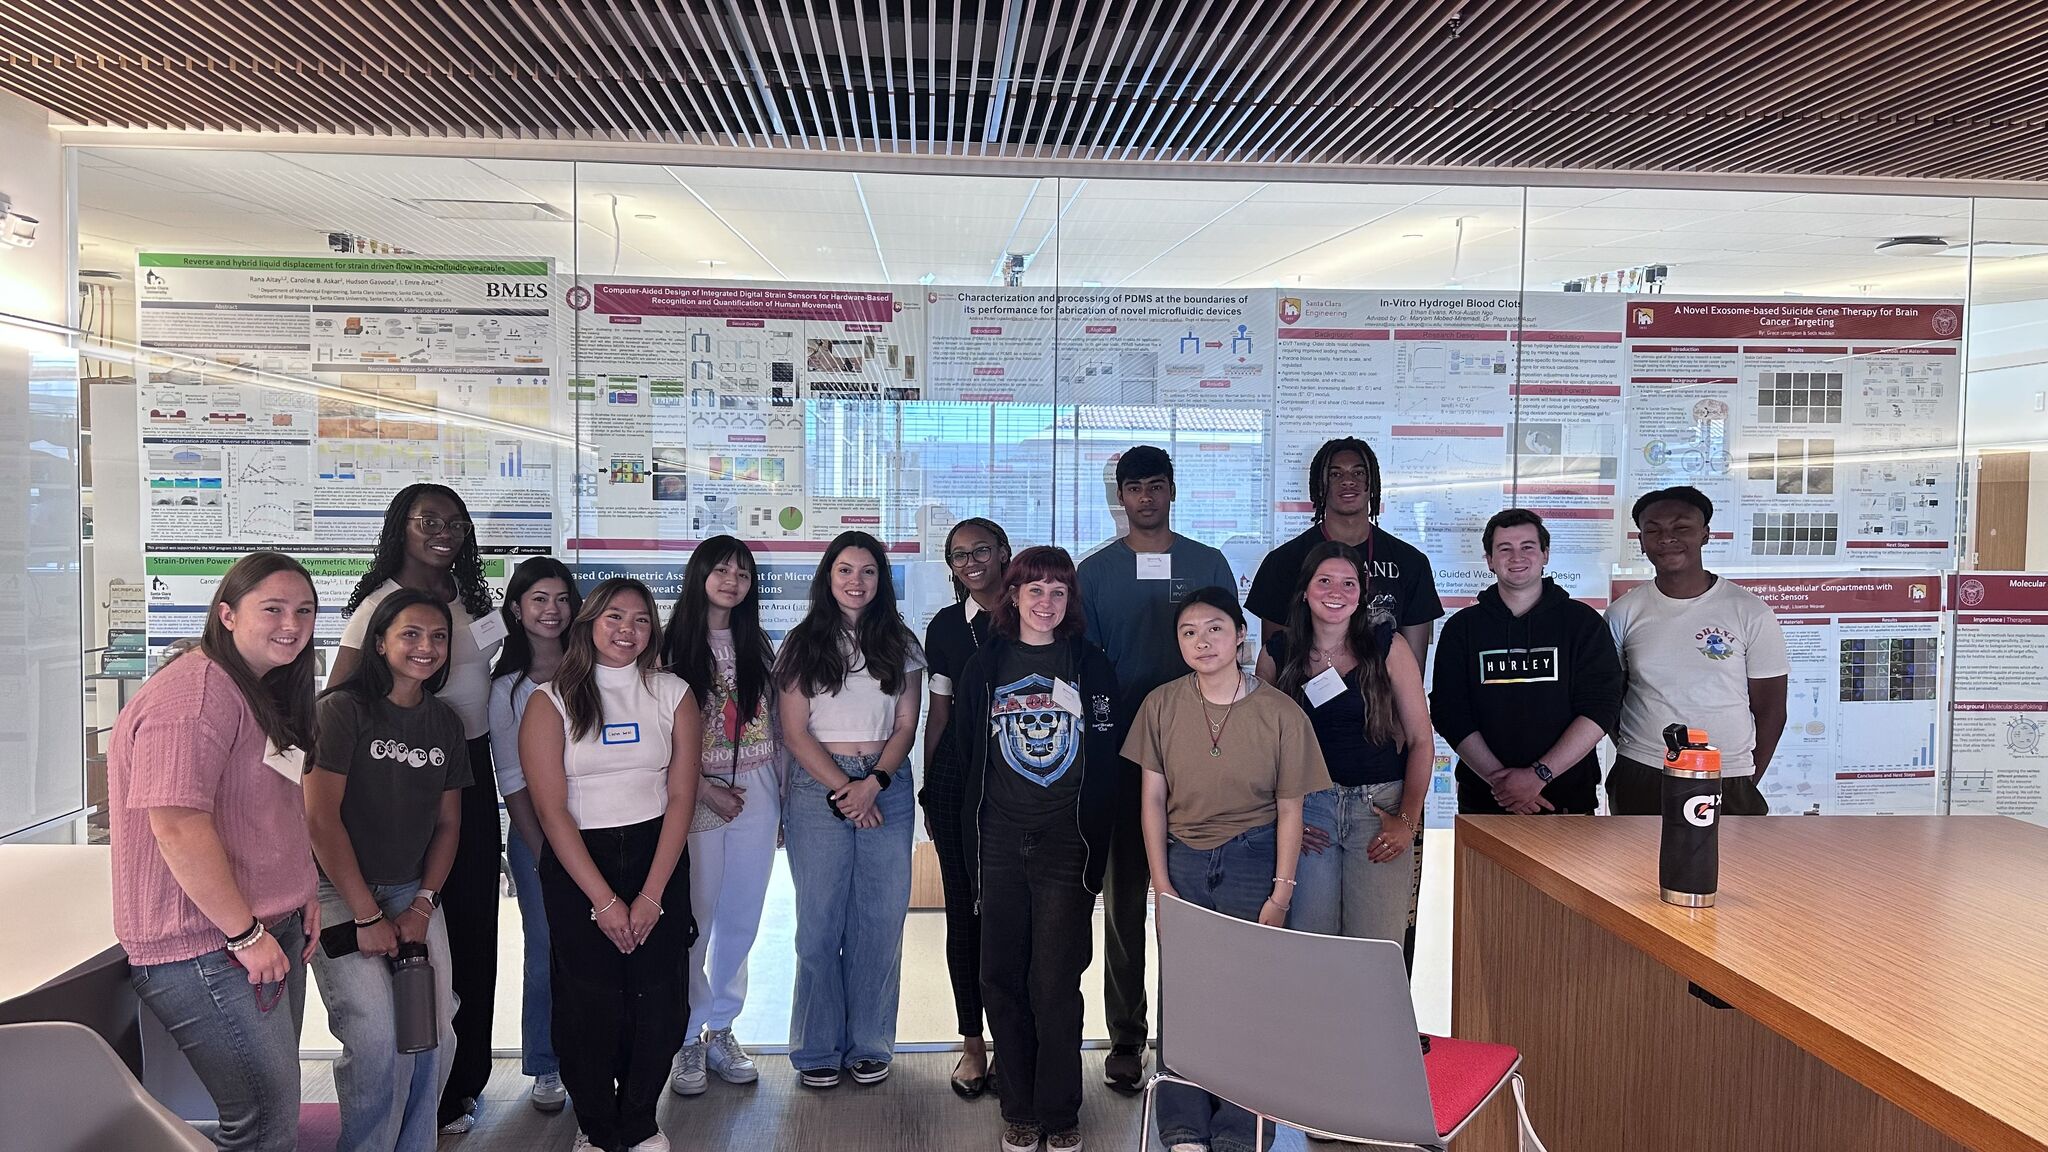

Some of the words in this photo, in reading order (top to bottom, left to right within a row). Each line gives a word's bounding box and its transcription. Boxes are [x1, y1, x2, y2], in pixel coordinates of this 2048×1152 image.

[233, 259, 257, 268] hybrid
[259, 259, 280, 268] liquid
[283, 260, 333, 269] displacement
[486, 283, 548, 298] BMES
[603, 287, 663, 296] Computer-Aided
[664, 288, 690, 297] Design
[701, 289, 738, 298] Integrated
[831, 293, 889, 301] Hardware-Based
[652, 297, 696, 306] Recognition
[713, 298, 764, 307] Quantification
[958, 293, 1036, 302] Characterization
[1038, 294, 1055, 302] and
[1058, 295, 1110, 304] processing
[1124, 295, 1152, 303] PDMS
[1184, 295, 1235, 304] boundaries
[1238, 295, 1248, 303] of
[1380, 299, 1416, 307] In-Vitro
[1418, 299, 1464, 309] Hydrogel
[964, 305, 975, 314] its
[978, 306, 1038, 315] performance
[1041, 306, 1053, 314] for
[1109, 307, 1118, 315] of
[1148, 307, 1203, 315] microfluidic
[1206, 307, 1242, 315] devices
[1711, 306, 1780, 315] Exosome-based
[1782, 307, 1813, 316] Suicide
[1816, 308, 1839, 316] Gene
[1841, 308, 1878, 318] Therapy
[1880, 308, 1892, 316] for
[1896, 308, 1918, 316] Brain
[1760, 318, 1790, 326] Cancer
[1793, 318, 1834, 327] Targeting
[767, 572, 782, 580] for
[1439, 570, 1471, 579] Guided
[1553, 571, 1581, 580] Design
[1821, 584, 1874, 593] Compartments
[2009, 580, 2047, 588] Molecular
[1696, 627, 1735, 643] OHANA
[1487, 658, 1551, 672] HURLEY
